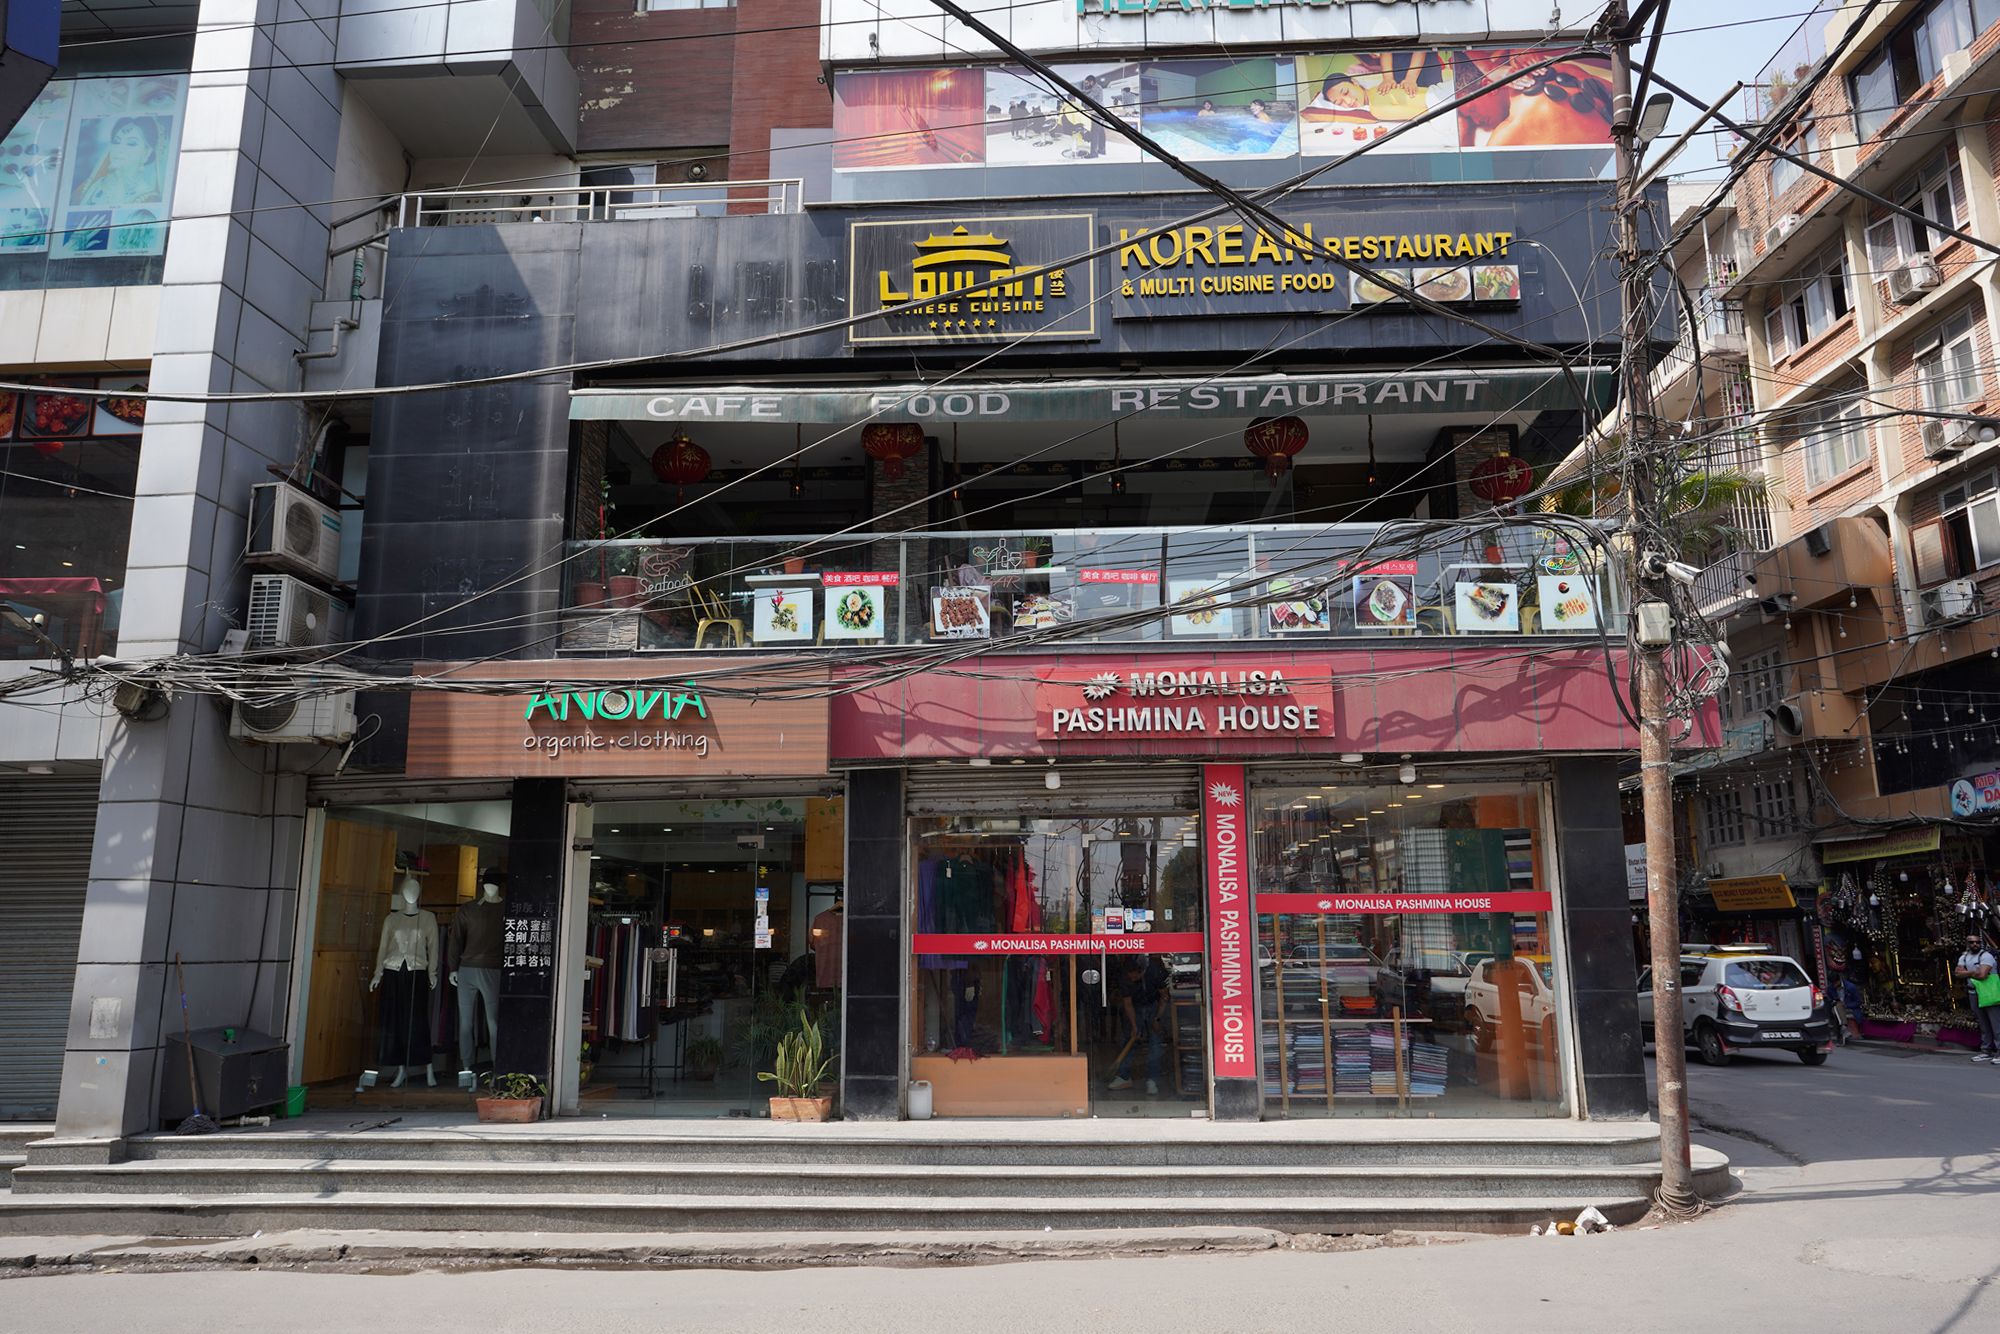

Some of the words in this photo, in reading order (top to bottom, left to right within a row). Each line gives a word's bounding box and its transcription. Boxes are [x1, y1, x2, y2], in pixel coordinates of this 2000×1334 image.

[1120, 222, 1314, 268] KOREAN
[1323, 231, 1513, 261] RESTAURANT
[1140, 278, 1195, 296] MULTI
[1201, 274, 1275, 294] CUISINE
[1281, 272, 1335, 292] FOOD
[970, 301, 1045, 313] CUISINE
[646, 395, 783, 418] CAFE
[871, 390, 1012, 418] FOOD
[1111, 378, 1491, 413] RESTAURANT
[1130, 669, 1289, 698] MONALISA
[1052, 706, 1206, 732] PASHMINA
[1218, 705, 1320, 731] HOUSE
[523, 732, 605, 757] organic
[617, 730, 708, 756] clothing
[1216, 814, 1239, 904] MONALISA
[1335, 899, 1393, 911] MONALISA
[1395, 898, 1452, 910] PASHMINA
[1455, 897, 1492, 909] HOUSE
[990, 938, 1048, 950] MONALISA
[1050, 938, 1106, 950] PASHMINA
[1109, 938, 1145, 950] HOUSE
[1219, 910, 1242, 1000] PASHMINA
[503, 955, 551, 968] 汇率咨询
[1222, 1005, 1245, 1063] HOUSE
